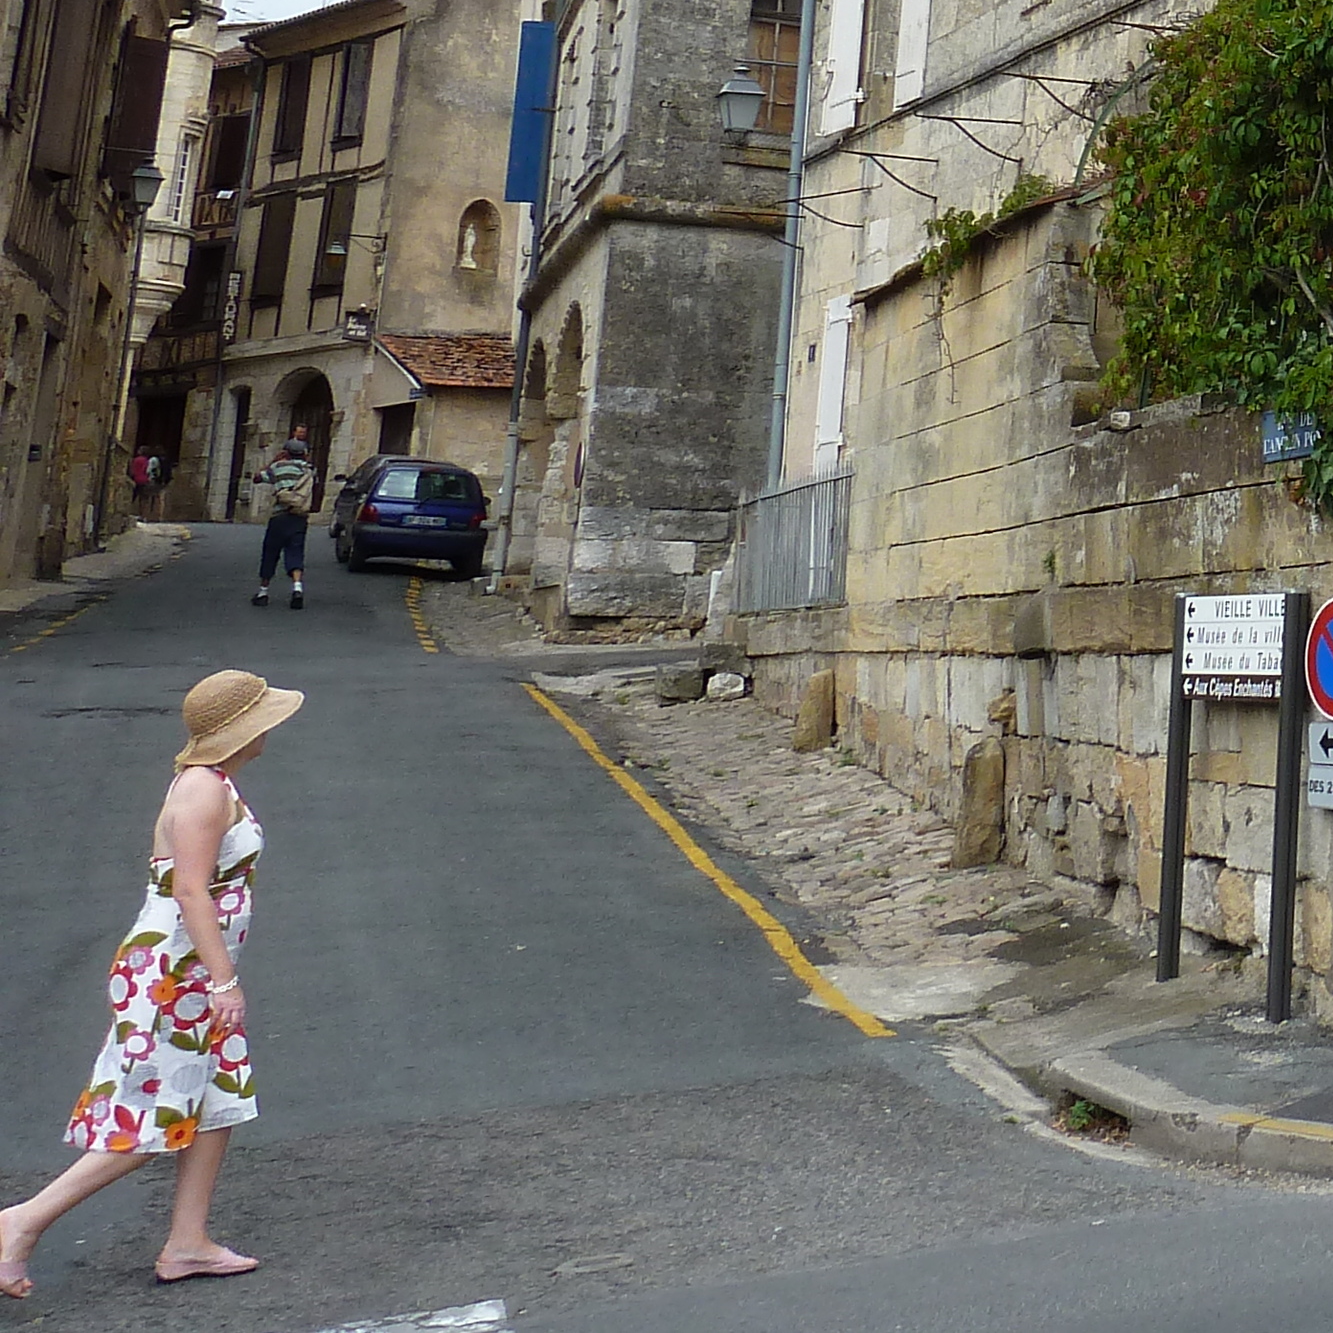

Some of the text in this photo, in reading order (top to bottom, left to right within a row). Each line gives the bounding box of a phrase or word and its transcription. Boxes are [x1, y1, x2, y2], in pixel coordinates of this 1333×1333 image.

[1214, 600, 1252, 618] VIEILLE
[1197, 626, 1283, 643] Musée de la vill
[1203, 652, 1282, 670] Musée du Taba
[1192, 677, 1208, 695] Aux
[1309, 779, 1324, 792] DES
[1327, 781, 1333, 794] 2
